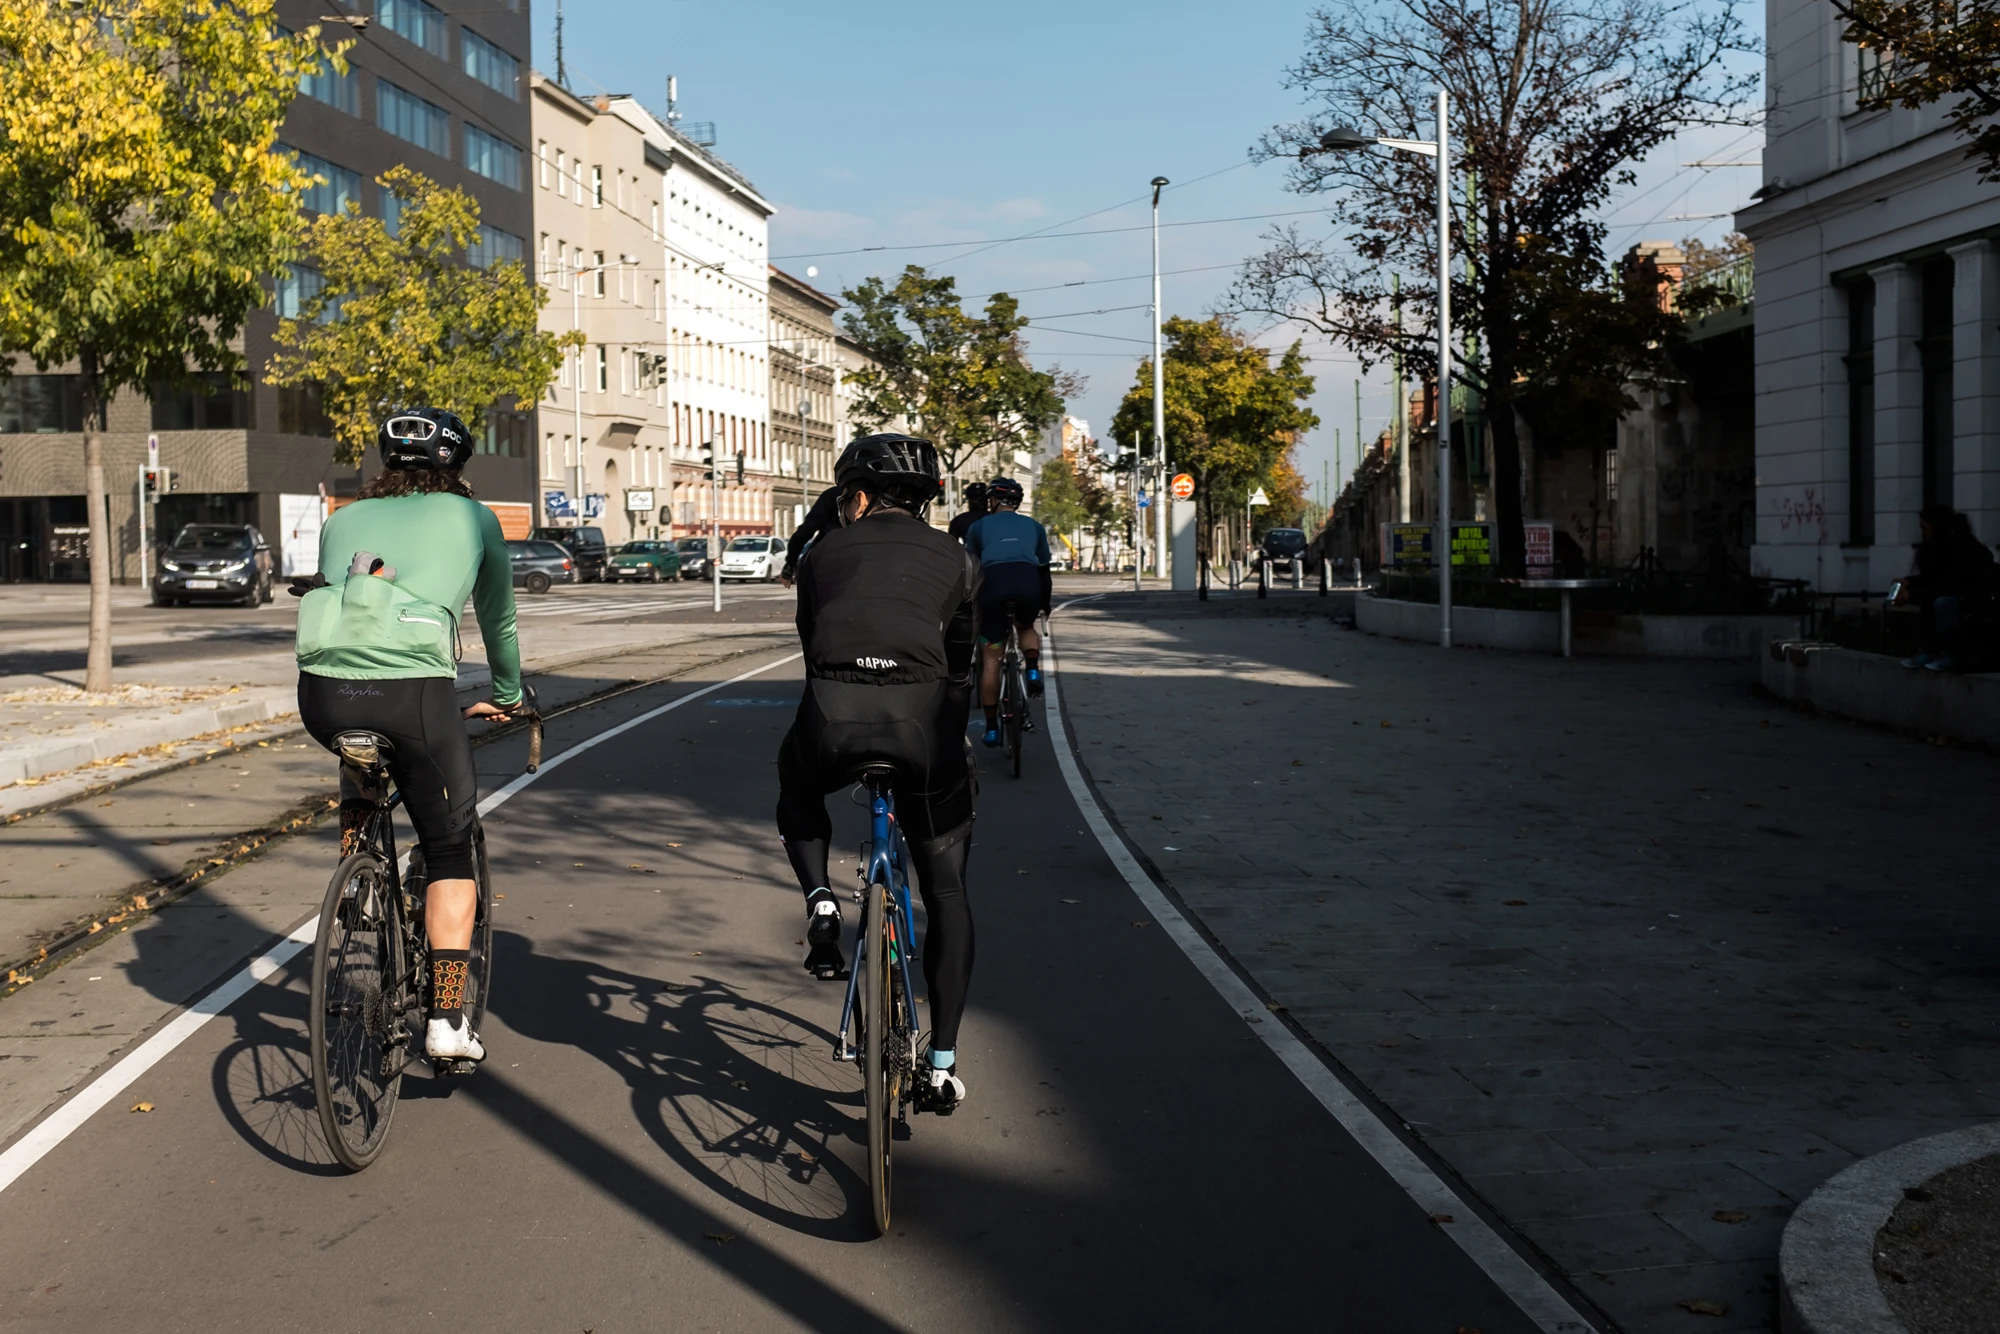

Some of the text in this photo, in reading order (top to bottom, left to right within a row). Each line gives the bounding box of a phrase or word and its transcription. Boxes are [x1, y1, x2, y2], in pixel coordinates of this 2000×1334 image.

[442, 427, 462, 444] POC
[1458, 527, 1483, 539] ROYAL
[1452, 539, 1488, 550] REPUBLIC
[856, 656, 898, 670] RAPHA
